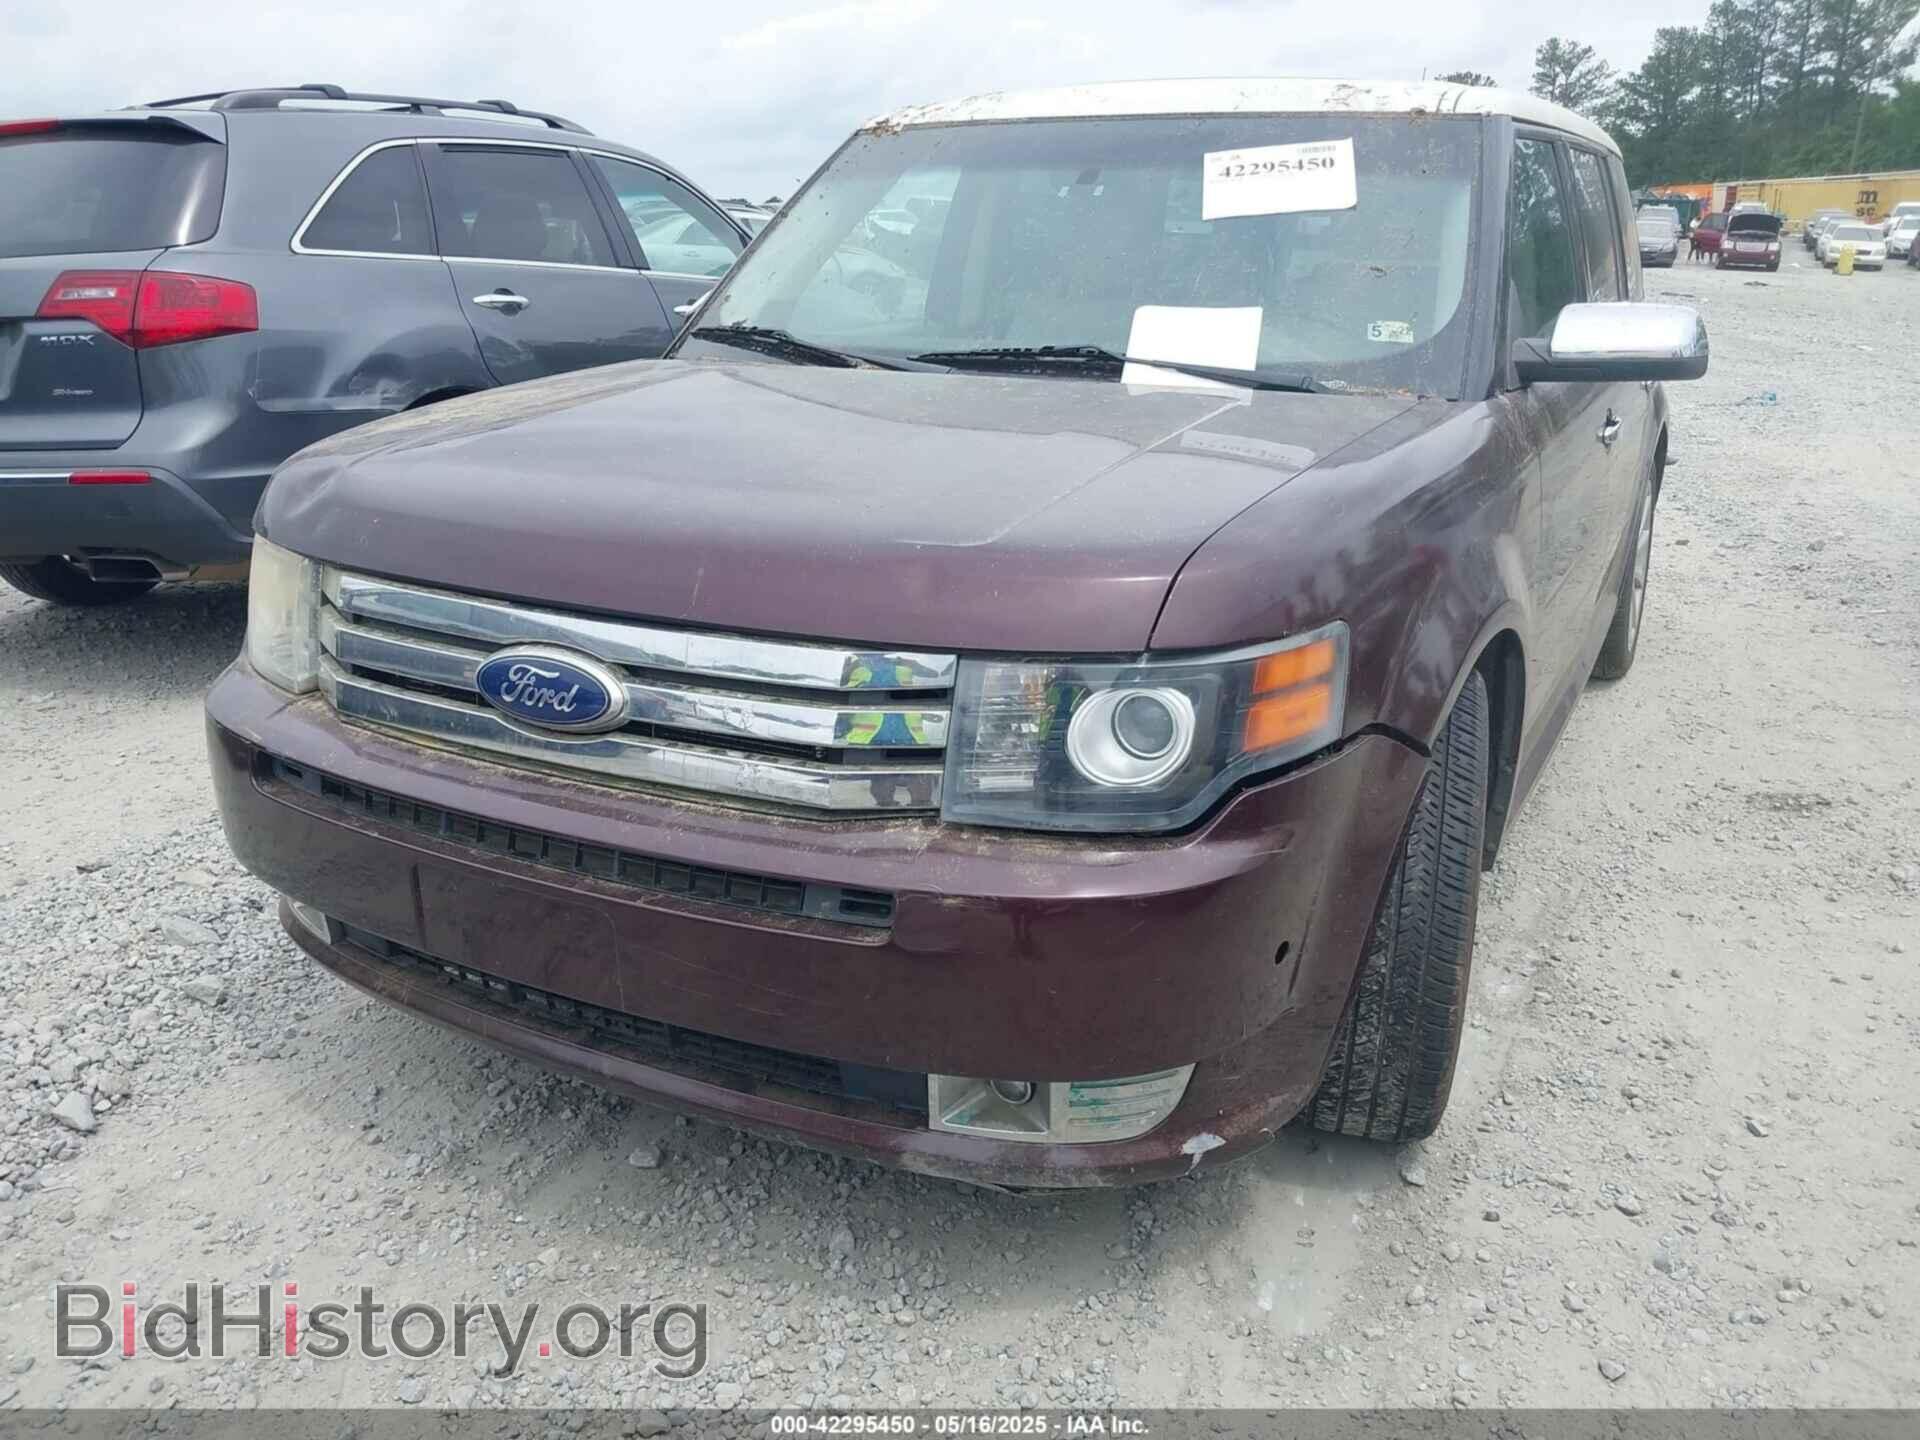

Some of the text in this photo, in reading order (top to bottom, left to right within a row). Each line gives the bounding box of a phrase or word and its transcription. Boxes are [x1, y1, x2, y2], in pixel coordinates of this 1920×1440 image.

[1219, 157, 1335, 178] 42295450
[1371, 325, 1382, 338] 5
[501, 664, 580, 712] Ford
